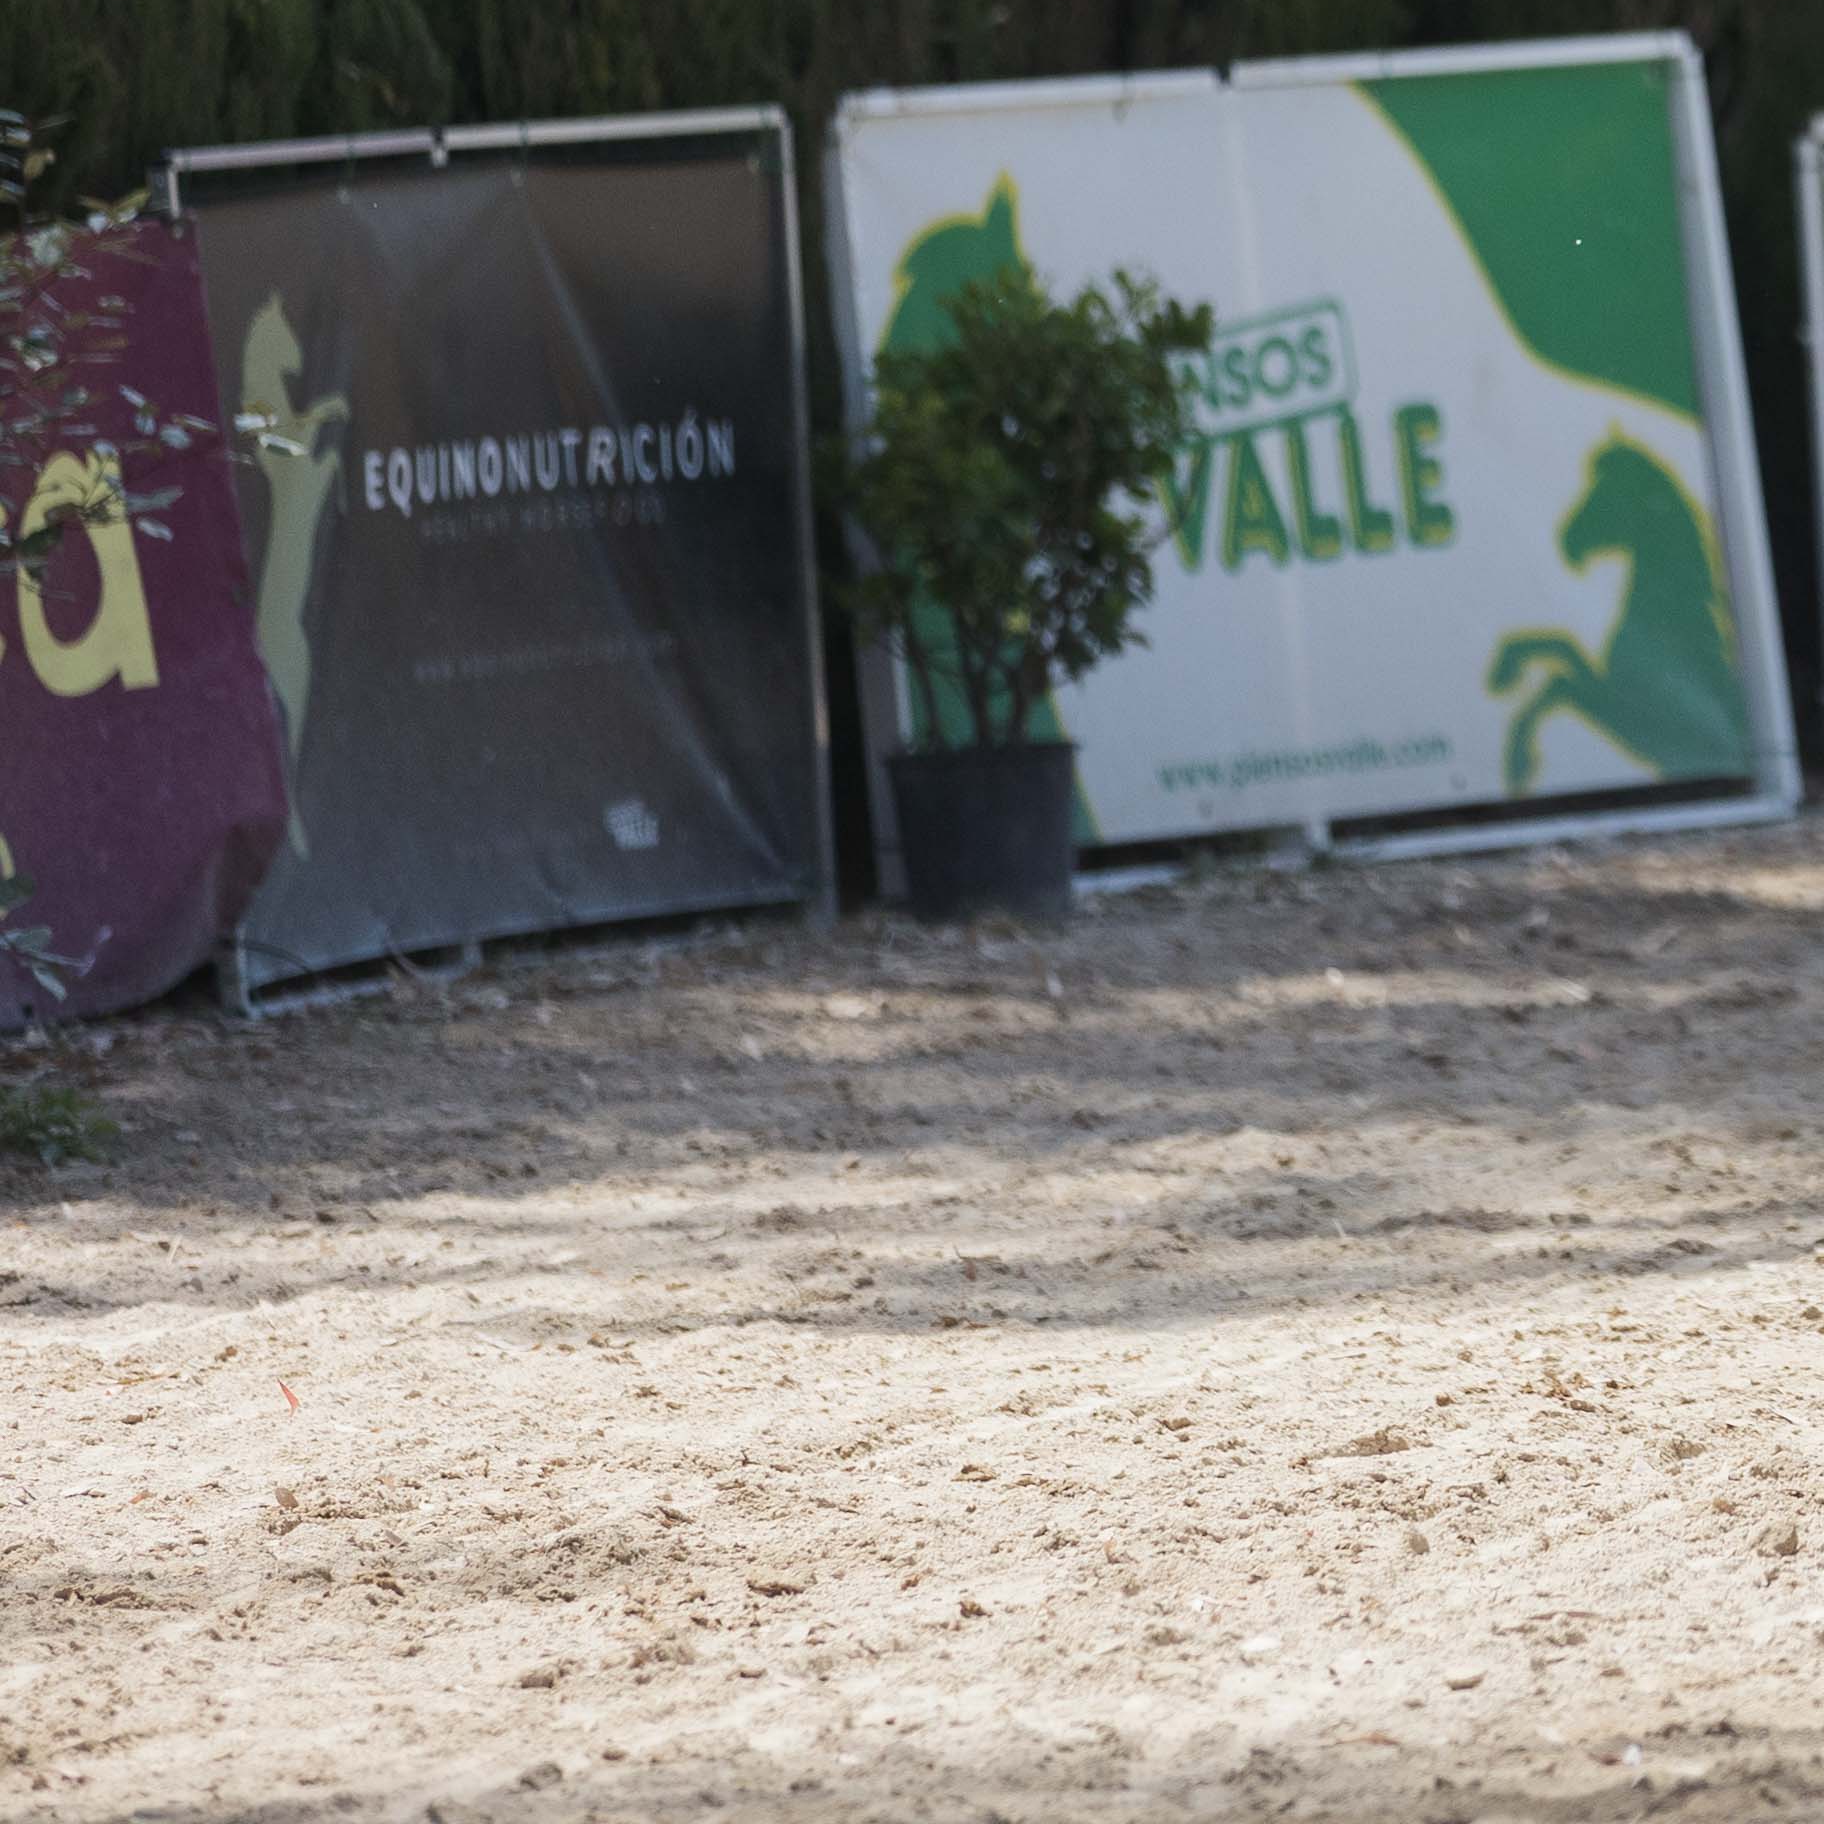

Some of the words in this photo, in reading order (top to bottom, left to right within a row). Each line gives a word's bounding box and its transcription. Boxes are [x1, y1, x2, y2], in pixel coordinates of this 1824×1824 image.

[1172, 325, 1332, 414] NSOS
[363, 407, 736, 518] EQUINONUTRICIÓN
[1153, 402, 1457, 574] VALLE
